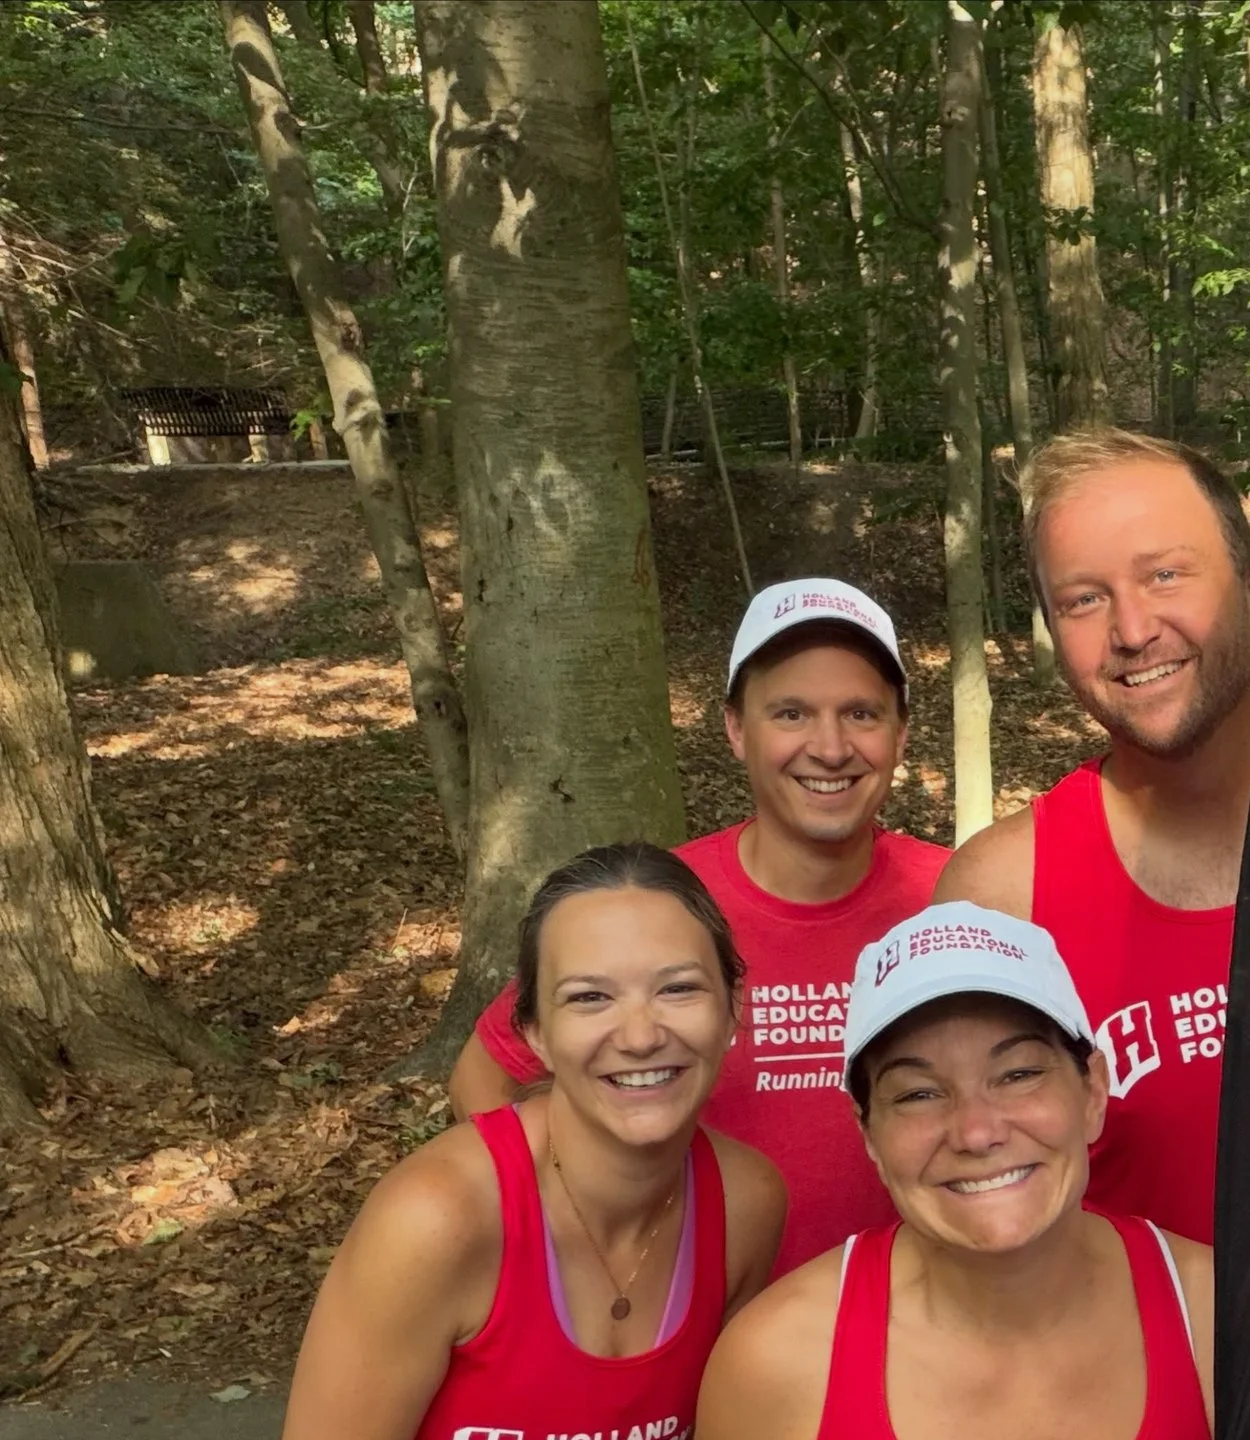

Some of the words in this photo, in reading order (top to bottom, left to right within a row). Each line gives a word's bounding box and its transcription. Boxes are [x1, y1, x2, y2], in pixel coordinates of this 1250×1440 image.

[909, 924, 992, 942] HOLLAND
[909, 934, 1029, 958] EDUCATIONAL
[909, 942, 1025, 962] FOUNDATION
[752, 981, 852, 1004] HOLLAN
[753, 1024, 846, 1047] FOUND
